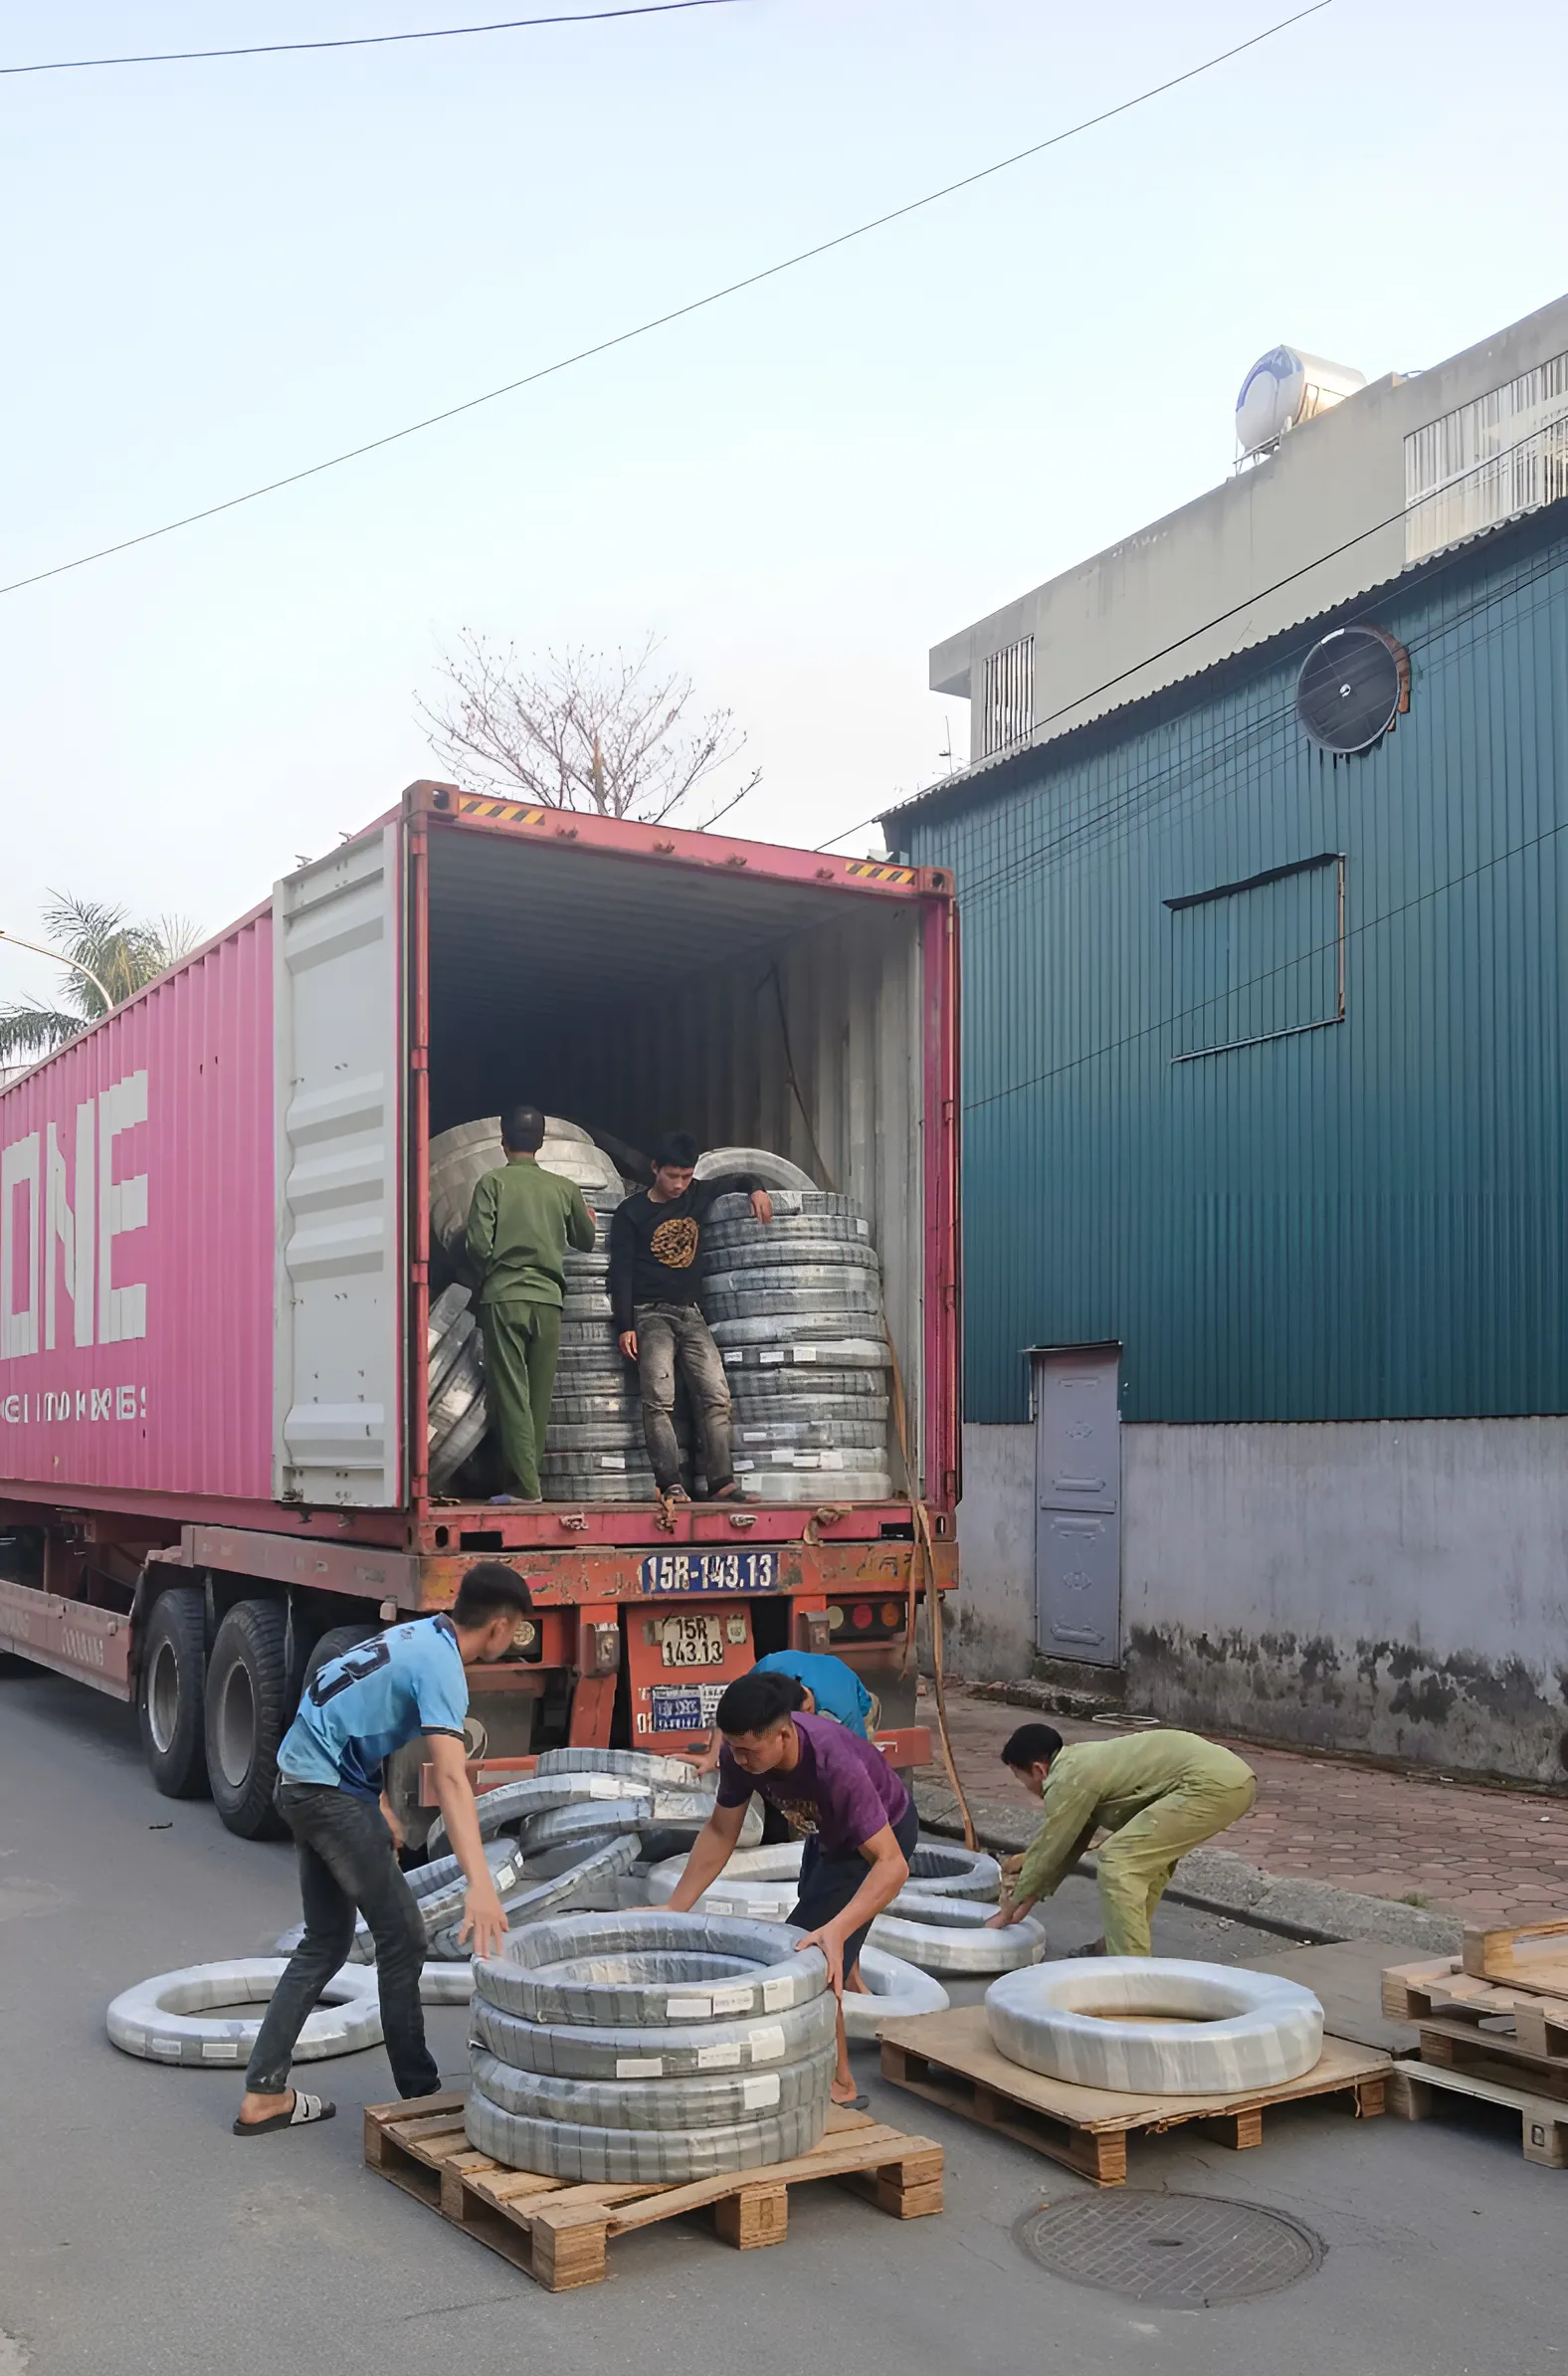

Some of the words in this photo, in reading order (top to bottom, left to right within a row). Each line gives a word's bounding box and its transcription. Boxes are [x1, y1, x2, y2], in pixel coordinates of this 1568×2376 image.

[1, 1069, 147, 1360] ONE
[647, 1554, 772, 1590] 15R-143.13
[677, 1616, 708, 1641] 15R
[665, 1641, 723, 1664] 143.13
